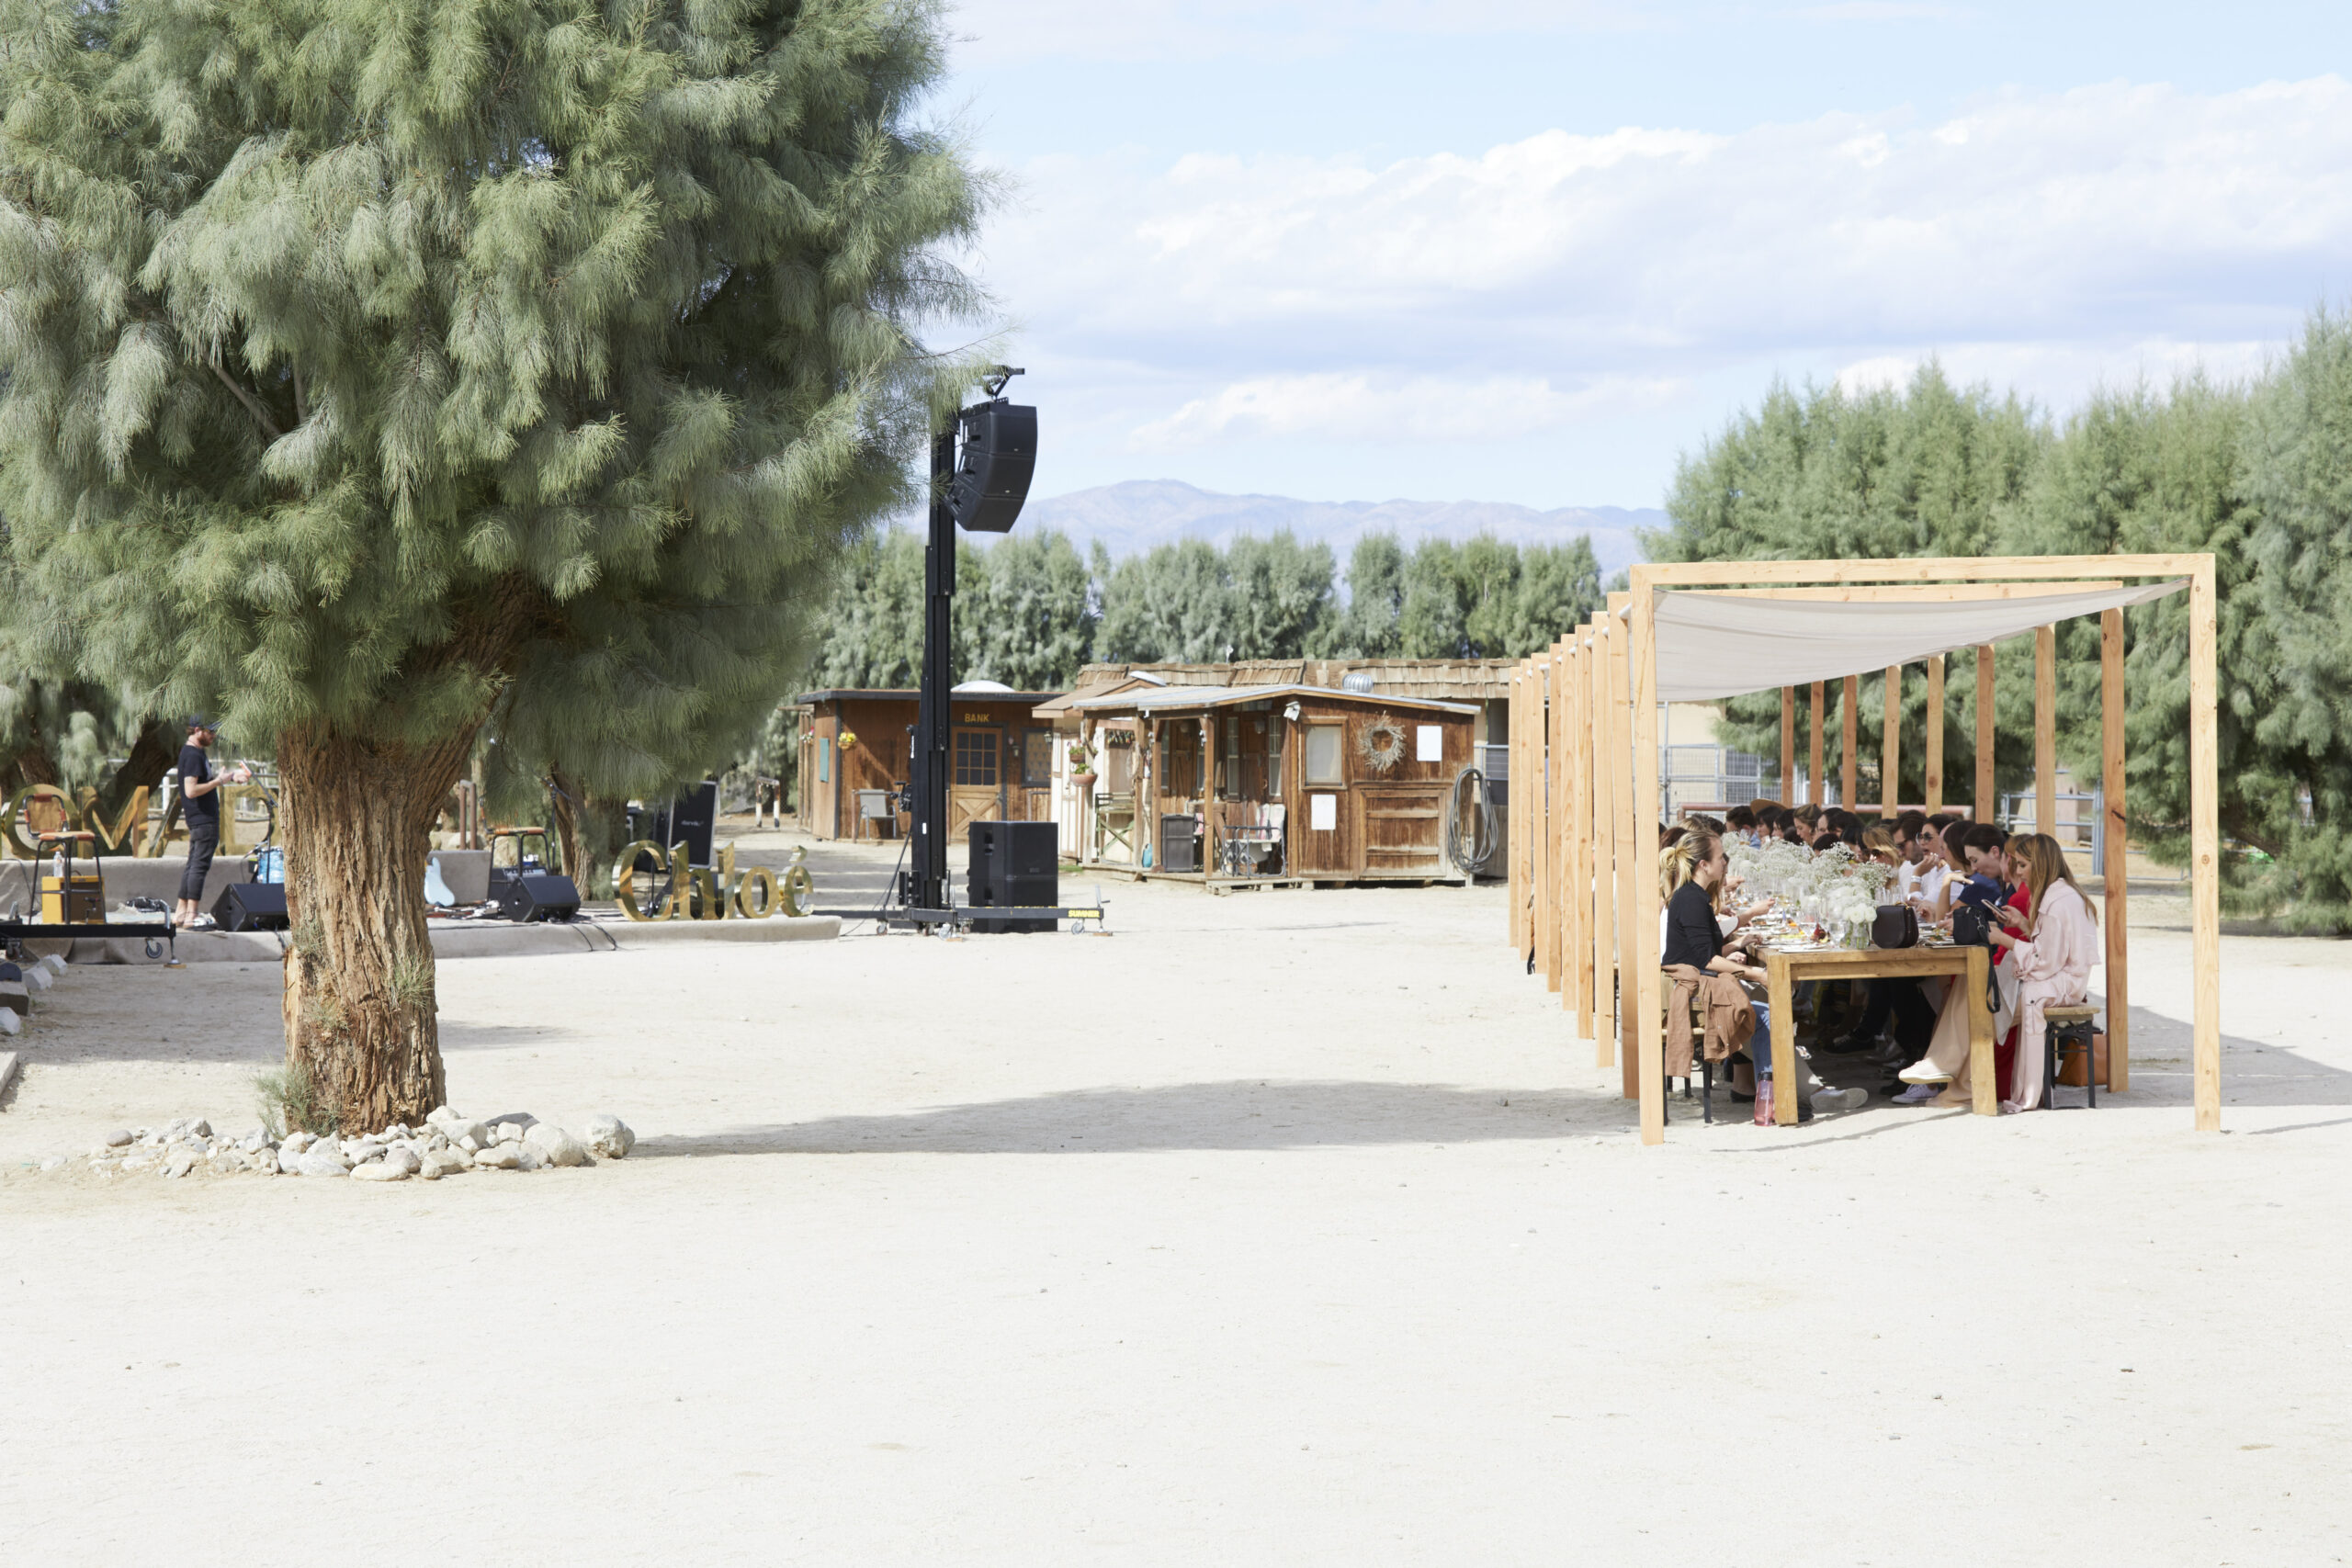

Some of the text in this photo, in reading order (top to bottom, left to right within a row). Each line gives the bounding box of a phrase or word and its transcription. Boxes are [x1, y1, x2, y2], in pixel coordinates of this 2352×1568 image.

[965, 713, 990, 723] BANK
[0, 784, 281, 859] OMD
[612, 840, 814, 922] Chloé
